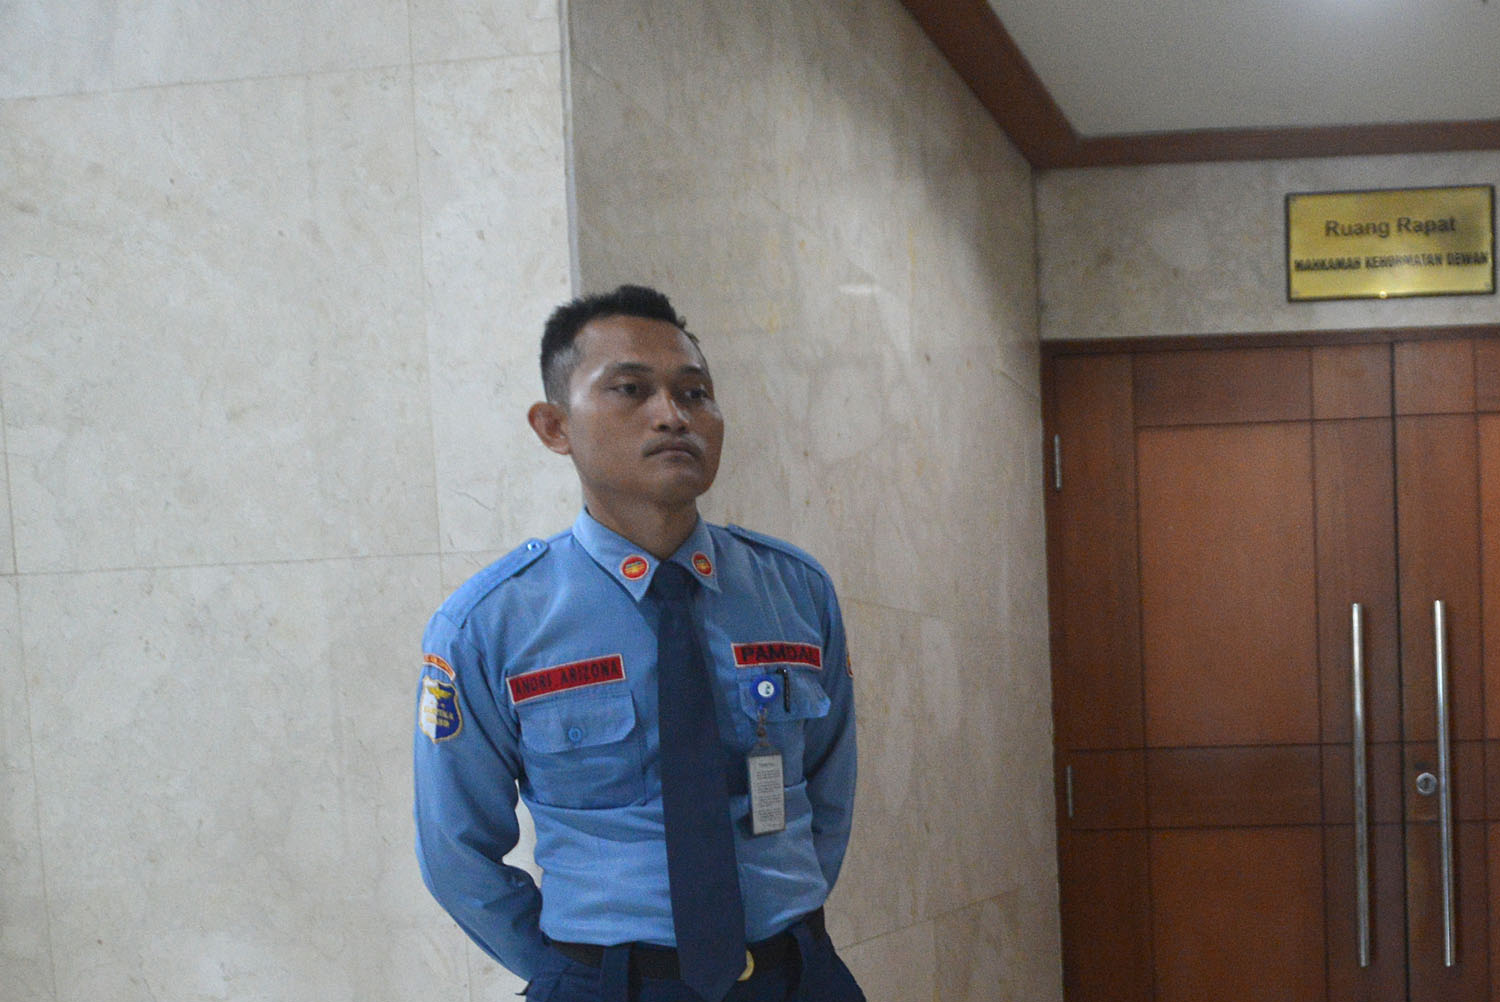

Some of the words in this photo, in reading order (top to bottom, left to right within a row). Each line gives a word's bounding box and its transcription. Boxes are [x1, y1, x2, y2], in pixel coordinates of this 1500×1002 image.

[1325, 219, 1390, 238] Ruang
[1397, 216, 1456, 236] Rapat
[1447, 251, 1488, 266] DEWAN
[741, 645, 817, 663] PAMDAL
[560, 659, 620, 685] ARIZONA
